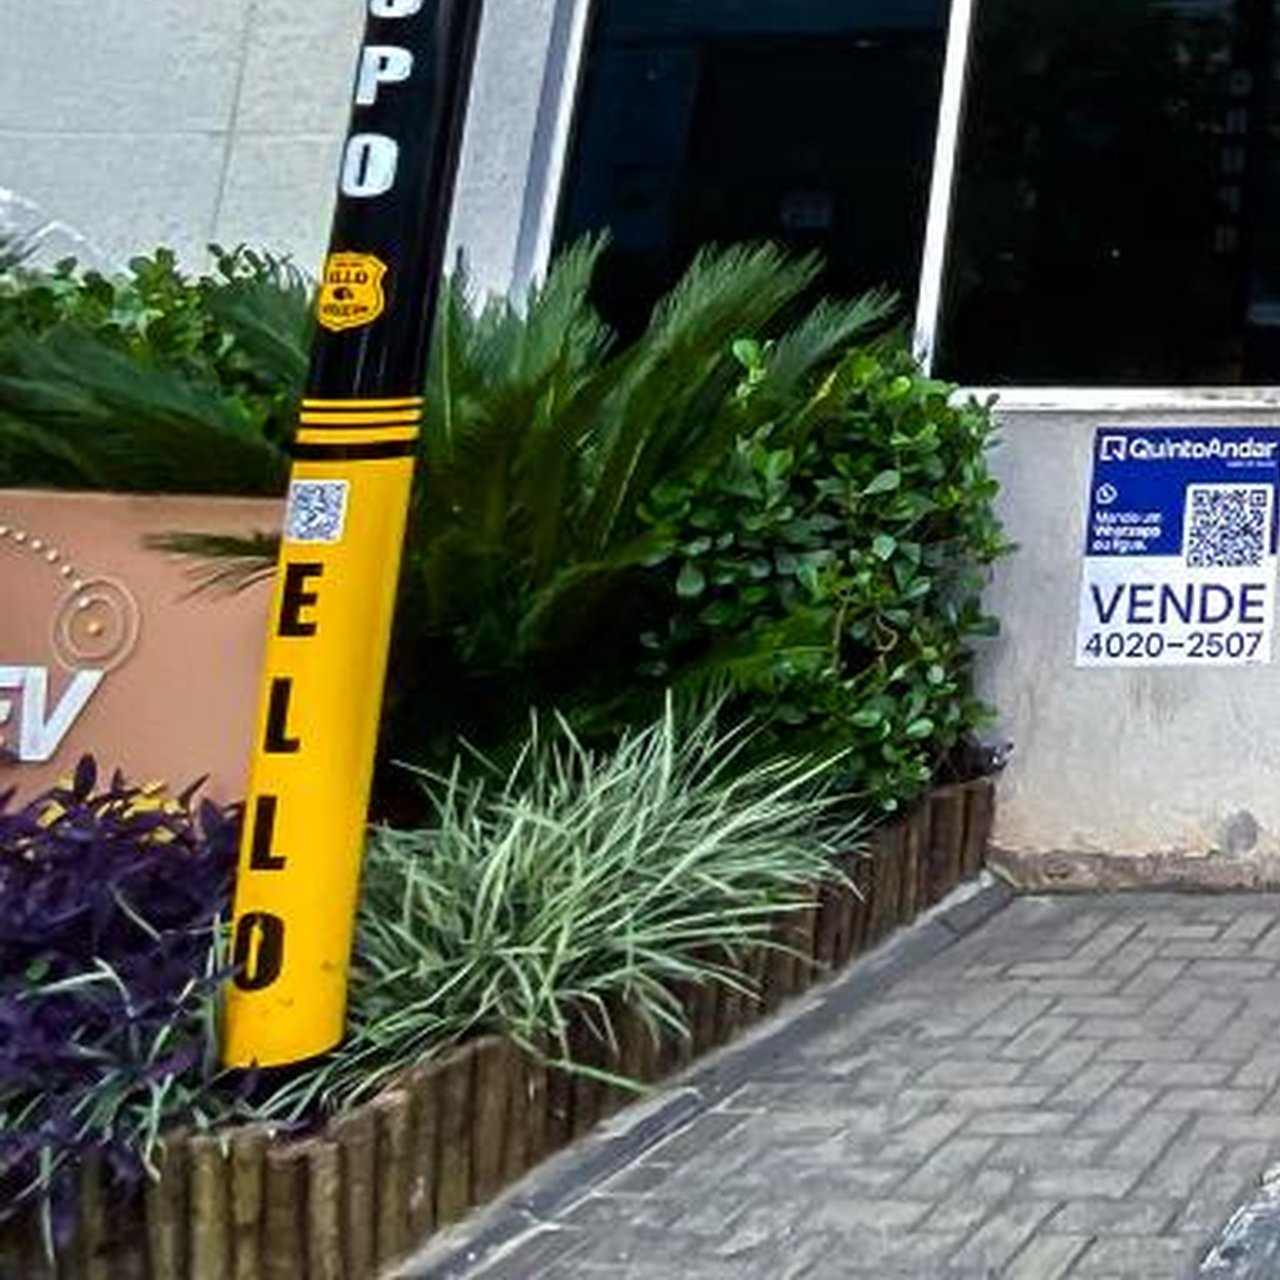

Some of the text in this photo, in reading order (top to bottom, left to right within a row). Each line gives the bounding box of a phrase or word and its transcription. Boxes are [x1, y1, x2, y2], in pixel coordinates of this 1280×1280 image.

[1129, 437, 1277, 460] QuintoAndar
[1090, 583, 1266, 624] VENDE
[1085, 632, 1262, 658] 4020-2507
[232, 561, 324, 991] ELLO
